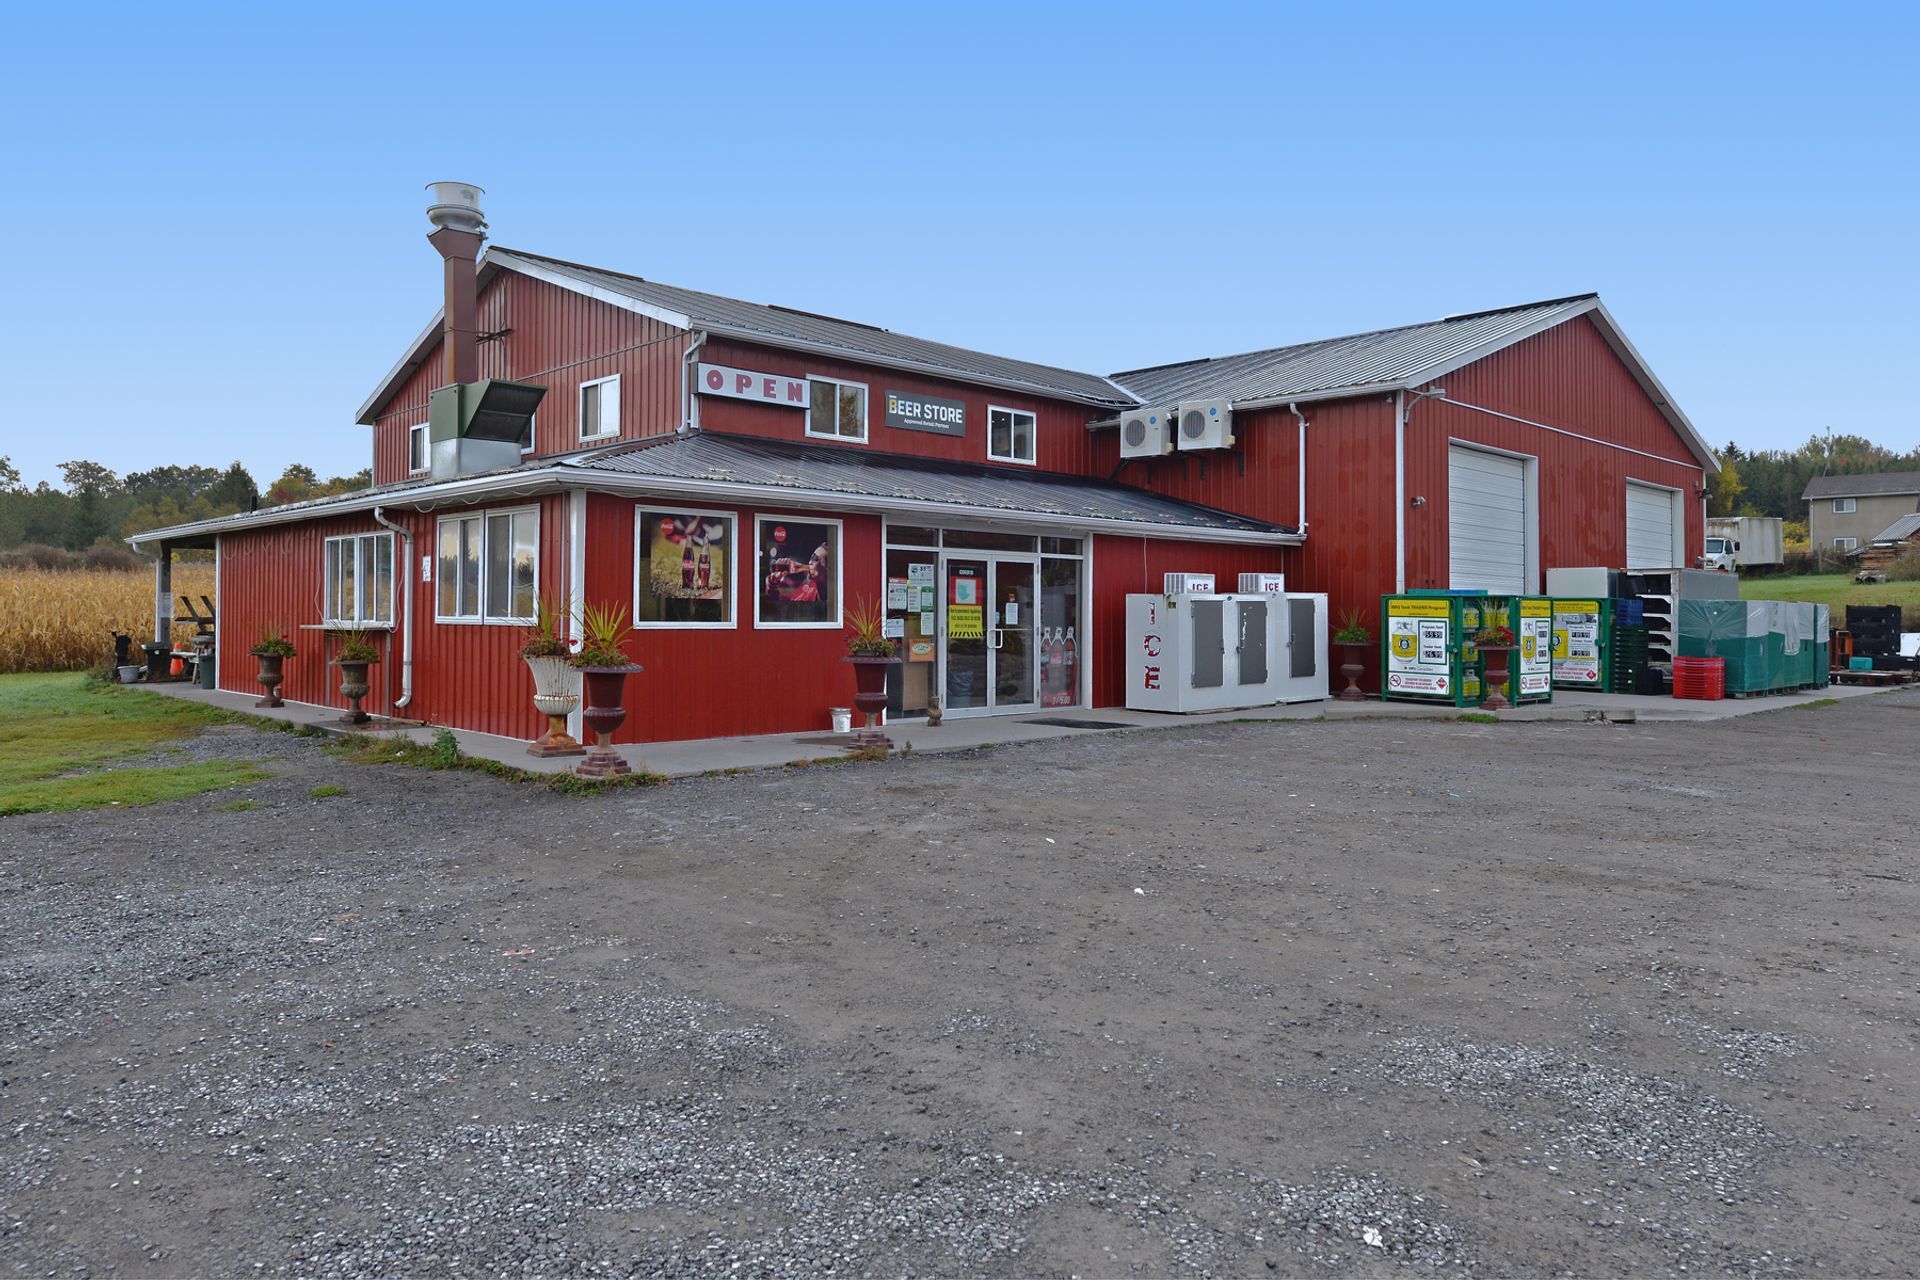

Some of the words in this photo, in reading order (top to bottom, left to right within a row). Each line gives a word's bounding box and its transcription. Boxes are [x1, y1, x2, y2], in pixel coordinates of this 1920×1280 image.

[706, 369, 803, 403] OPEN
[889, 398, 921, 418] BEER
[924, 404, 963, 423] STORE
[1193, 583, 1208, 591] ICE
[1265, 583, 1279, 591] ICE
[1144, 602, 1161, 689] ICE
